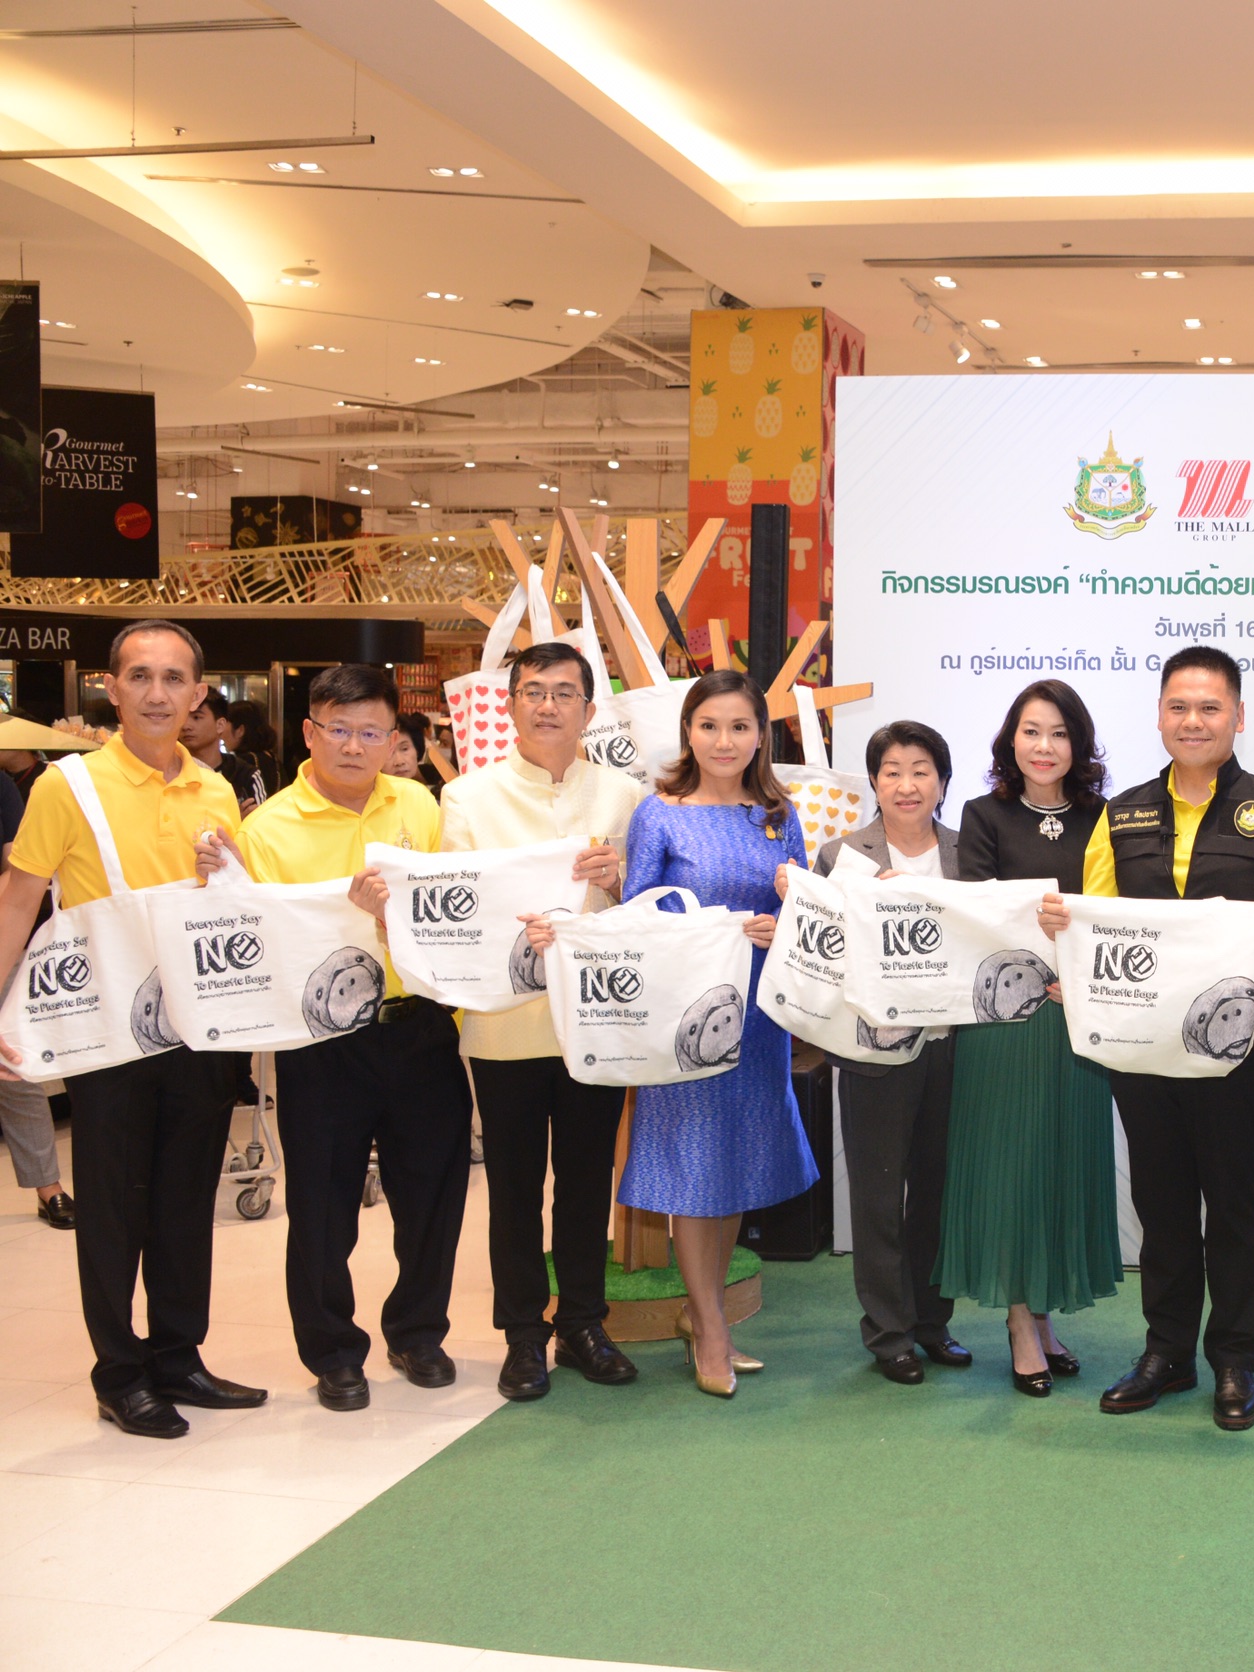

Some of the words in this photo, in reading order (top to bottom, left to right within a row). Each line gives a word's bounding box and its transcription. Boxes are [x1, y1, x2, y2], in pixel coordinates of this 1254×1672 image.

[65, 438, 125, 453] Gourmet
[1174, 521, 1205, 533] THE
[1211, 521, 1254, 533] MALL
[1192, 534, 1237, 542] GROUP
[881, 565, 1070, 595] กิจกรรมรณรงค์
[1154, 612, 1226, 643] วันพุธที่
[28, 627, 71, 650] BAR
[940, 653, 962, 671] ณ
[1110, 646, 1136, 672] ชั้น
[1145, 653, 1162, 672] G
[421, 928, 456, 938] Plastic
[457, 928, 483, 940] Bags
[797, 955, 823, 974] Plastic
[823, 966, 845, 980] Bags
[892, 961, 923, 971] Plastic
[924, 960, 948, 971] Bags
[208, 977, 244, 990] Plastic
[245, 974, 272, 986] Bags
[1100, 985, 1133, 998] Plastic
[1133, 989, 1159, 1002] Bags
[40, 999, 74, 1013] Plastic
[76, 994, 100, 1007] Bags
[590, 1008, 622, 1018] Plastic
[624, 1009, 649, 1020] Bags
